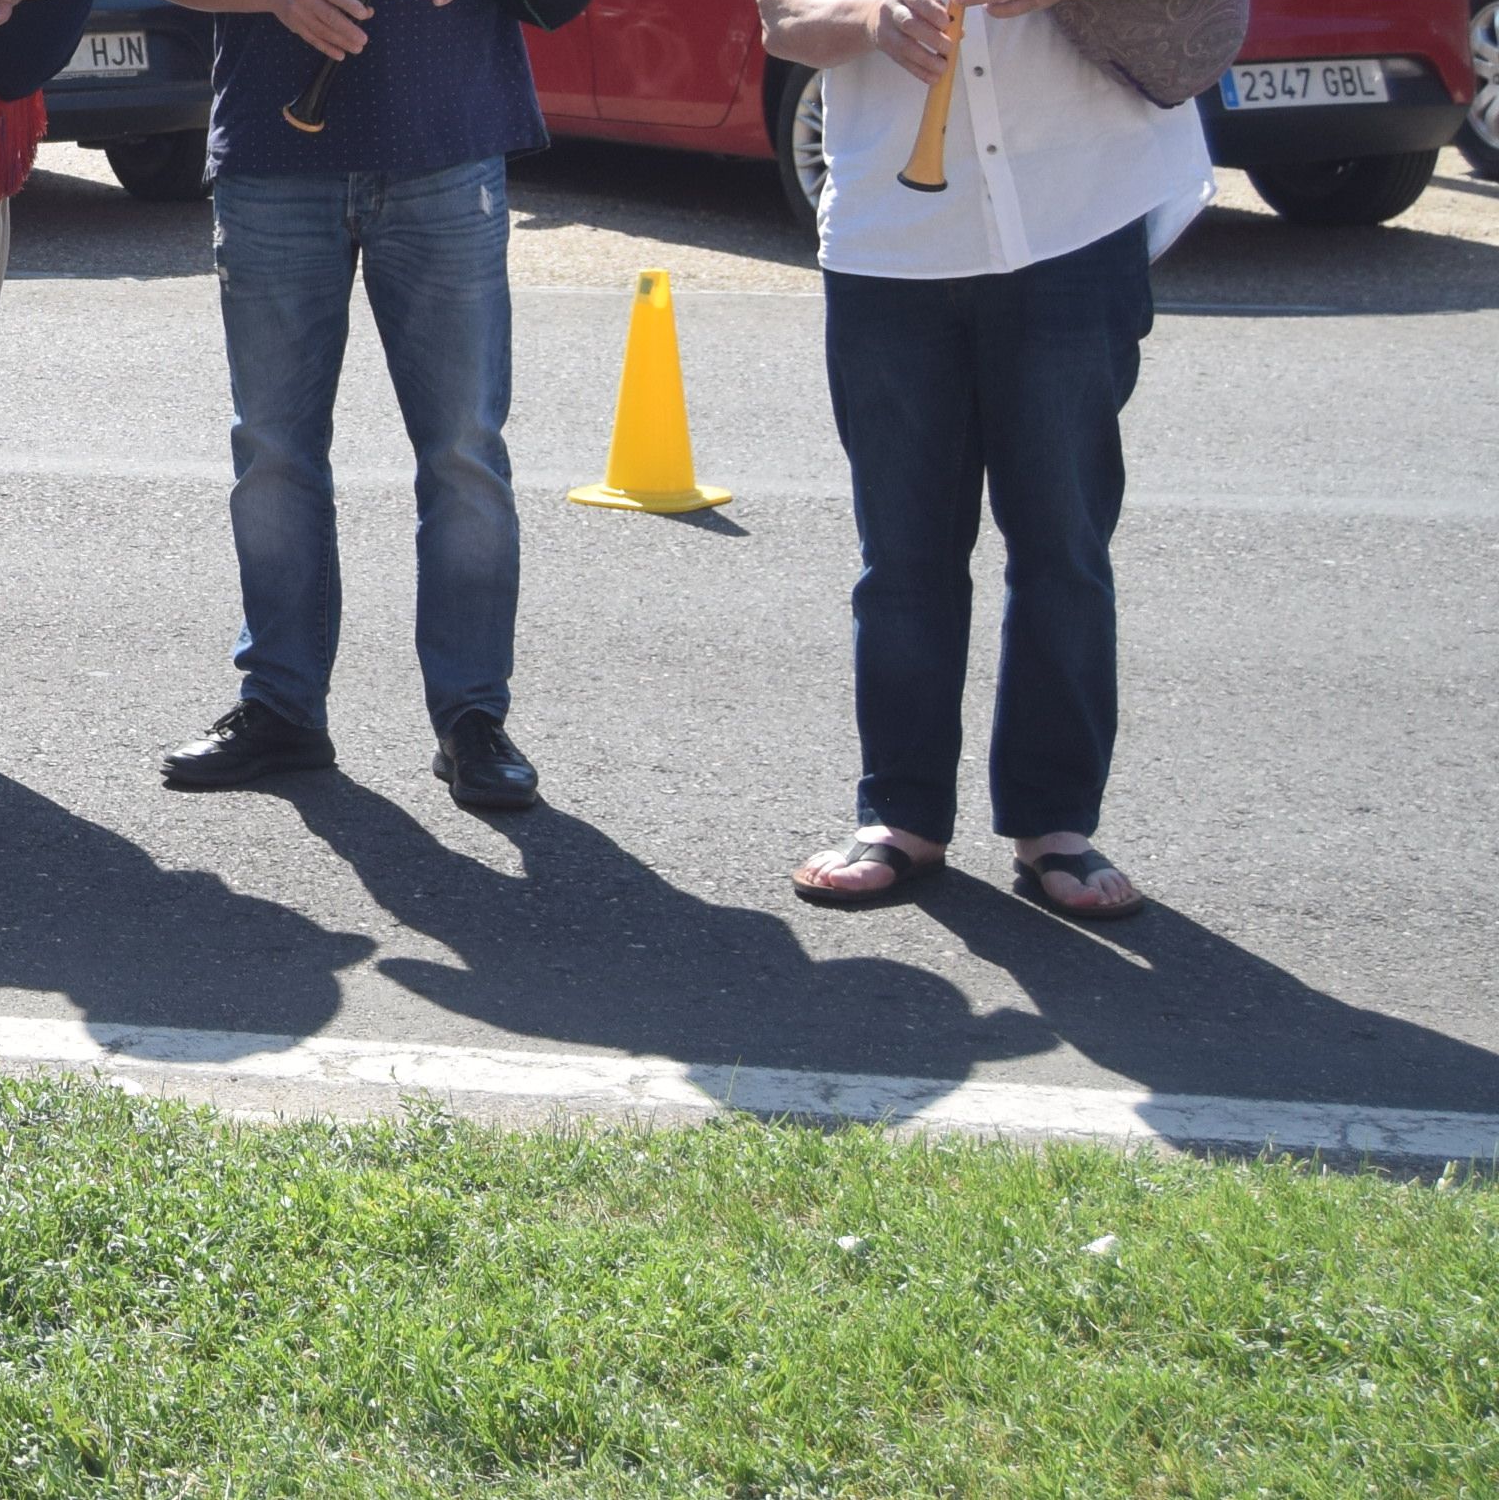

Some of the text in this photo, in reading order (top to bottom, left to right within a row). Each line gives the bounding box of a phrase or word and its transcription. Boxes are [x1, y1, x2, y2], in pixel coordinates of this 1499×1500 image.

[90, 35, 144, 66] HJN
[1241, 65, 1376, 102] 2347 GBL
